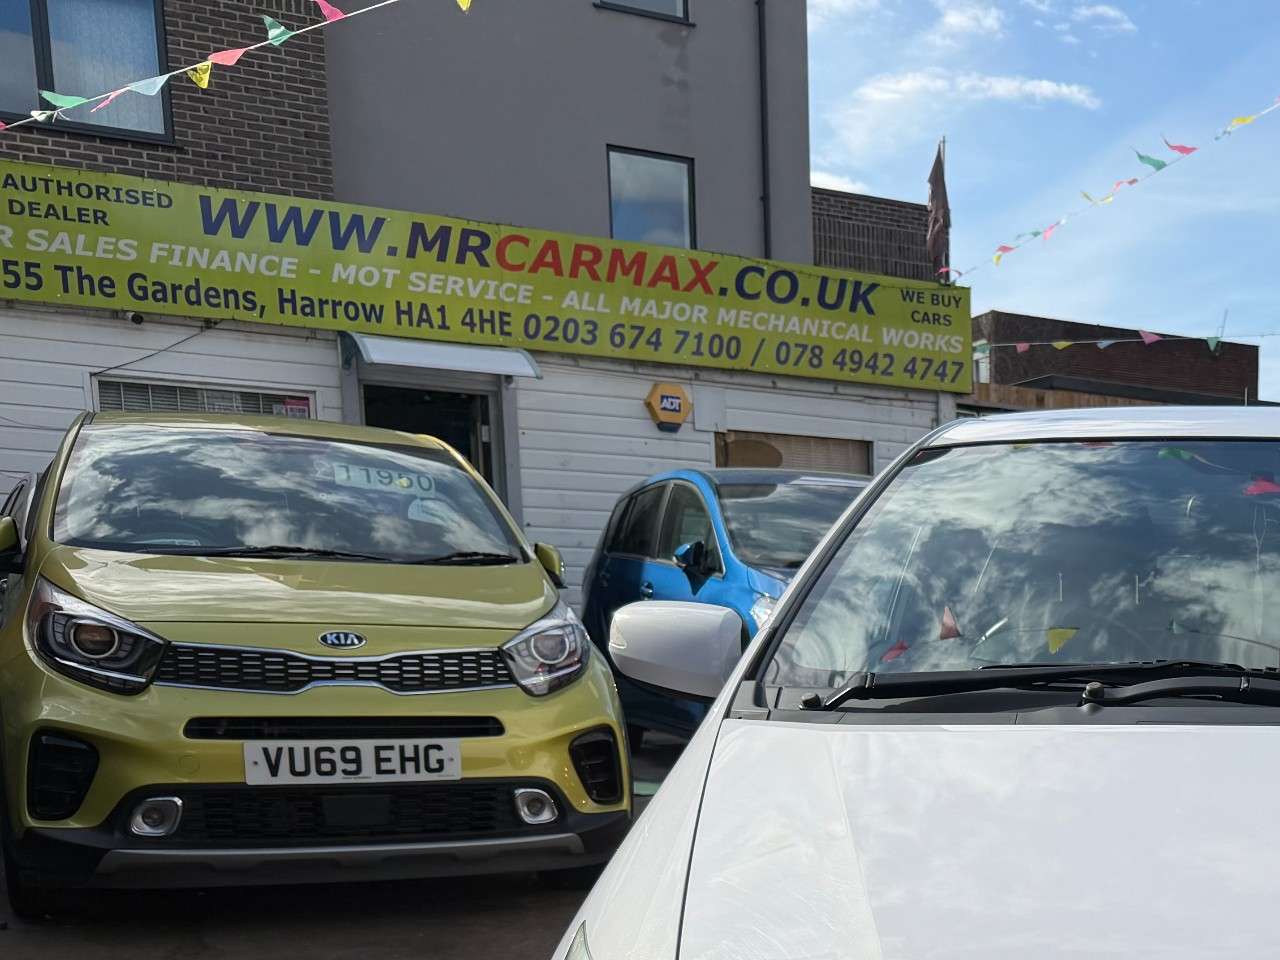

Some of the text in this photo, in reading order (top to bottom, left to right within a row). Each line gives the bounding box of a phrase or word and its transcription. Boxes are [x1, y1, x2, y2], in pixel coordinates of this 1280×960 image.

[2, 173, 173, 208] AUTHORISED
[8, 199, 109, 225] DEALER
[199, 195, 880, 316] WWW.MRCARMAX.CO.UK
[26, 229, 138, 260] SALES
[150, 242, 299, 279] FINANCE
[332, 263, 401, 289] MOT
[408, 272, 534, 305] SERVICE
[561, 290, 610, 313] ALL
[620, 297, 709, 324] MAJOR
[717, 307, 874, 343] MECHANICAL
[882, 327, 964, 353] WORKS
[901, 288, 962, 309] WE BUY
[2, 259, 44, 291] 55
[54, 264, 116, 298] The
[127, 272, 265, 318] Gardens,
[278, 288, 385, 324] Harrow
[395, 300, 450, 330] HA1
[461, 308, 512, 337] 4HE
[524, 314, 598, 345] 0203
[609, 323, 662, 351] 674
[673, 330, 741, 360] 7100
[776, 341, 824, 369] 078
[833, 348, 894, 377] 4942
[904, 357, 964, 384] 4747
[911, 310, 952, 326] CARS
[326, 632, 359, 645] KIA
[262, 744, 445, 777] VU69 EHG
